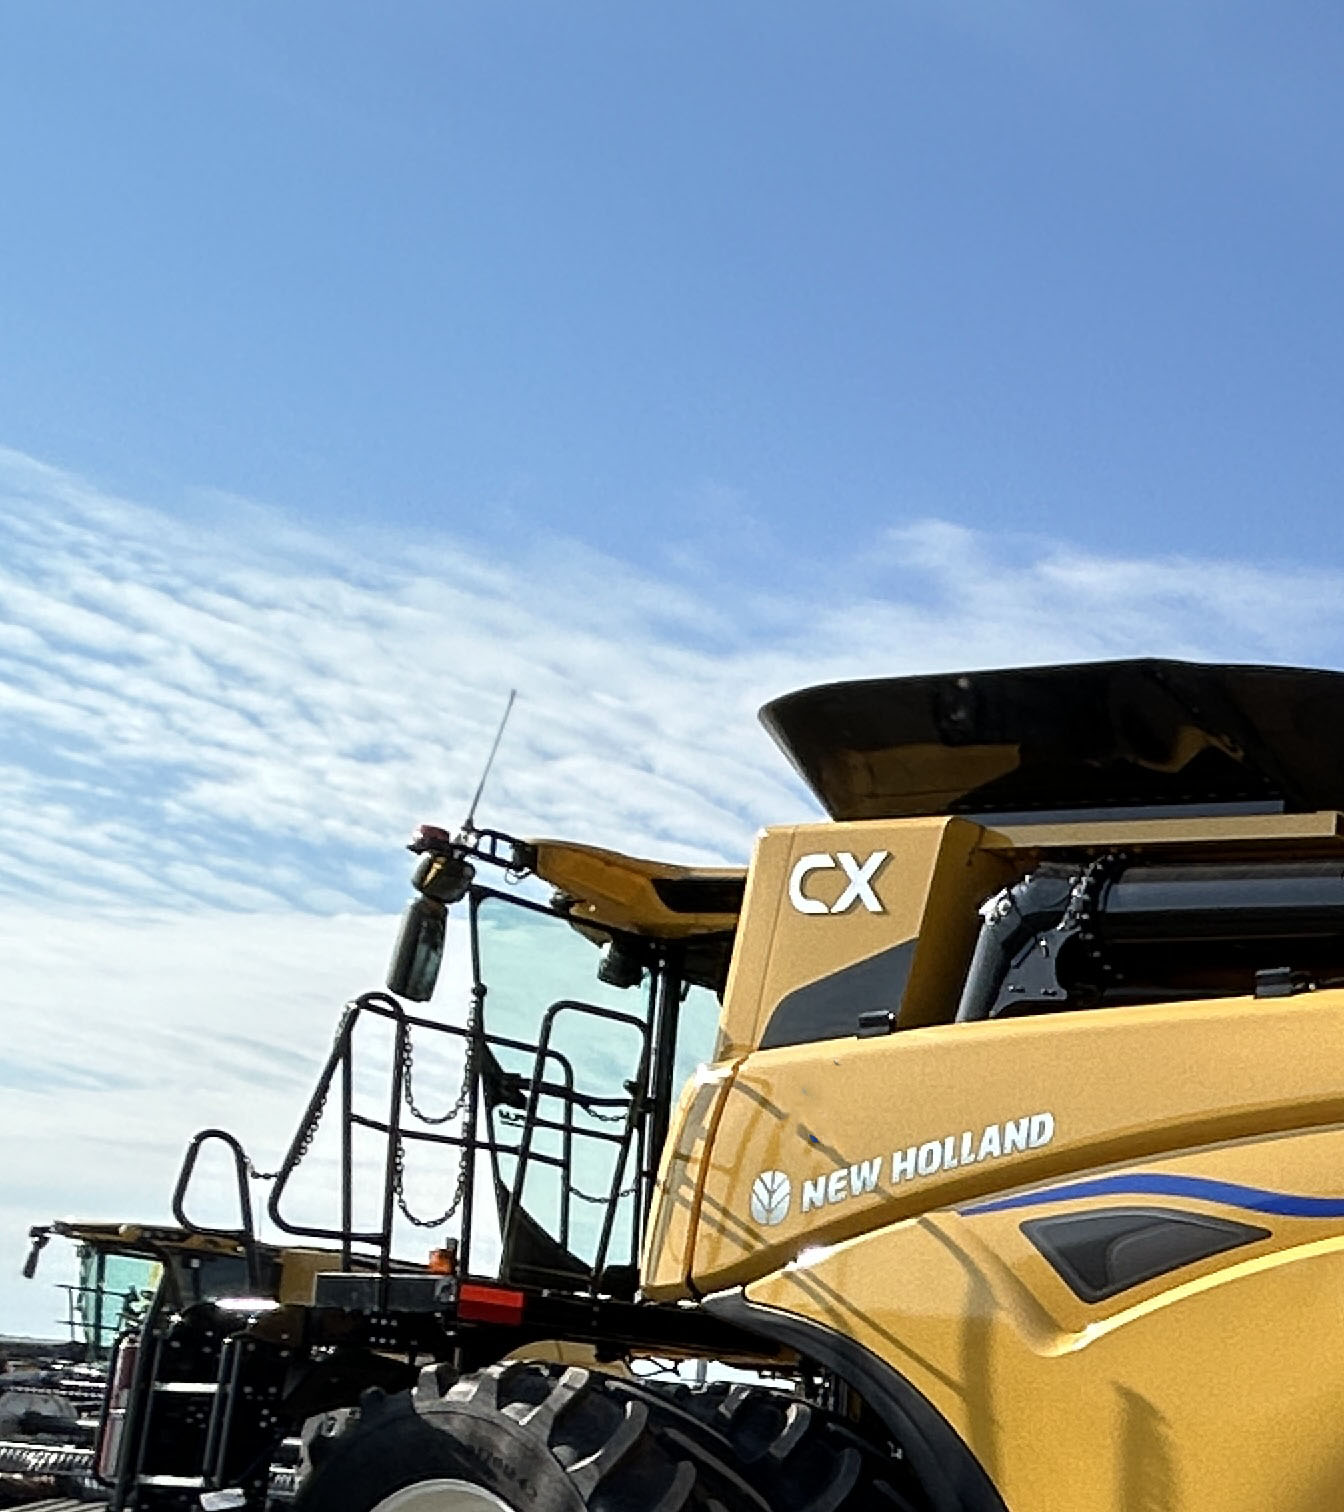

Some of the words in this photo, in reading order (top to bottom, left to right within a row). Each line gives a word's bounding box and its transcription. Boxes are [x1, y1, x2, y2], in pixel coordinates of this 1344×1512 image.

[788, 849, 889, 914] CX
[801, 1156, 882, 1212] NEW
[891, 1112, 1055, 1184] HOLLAND
